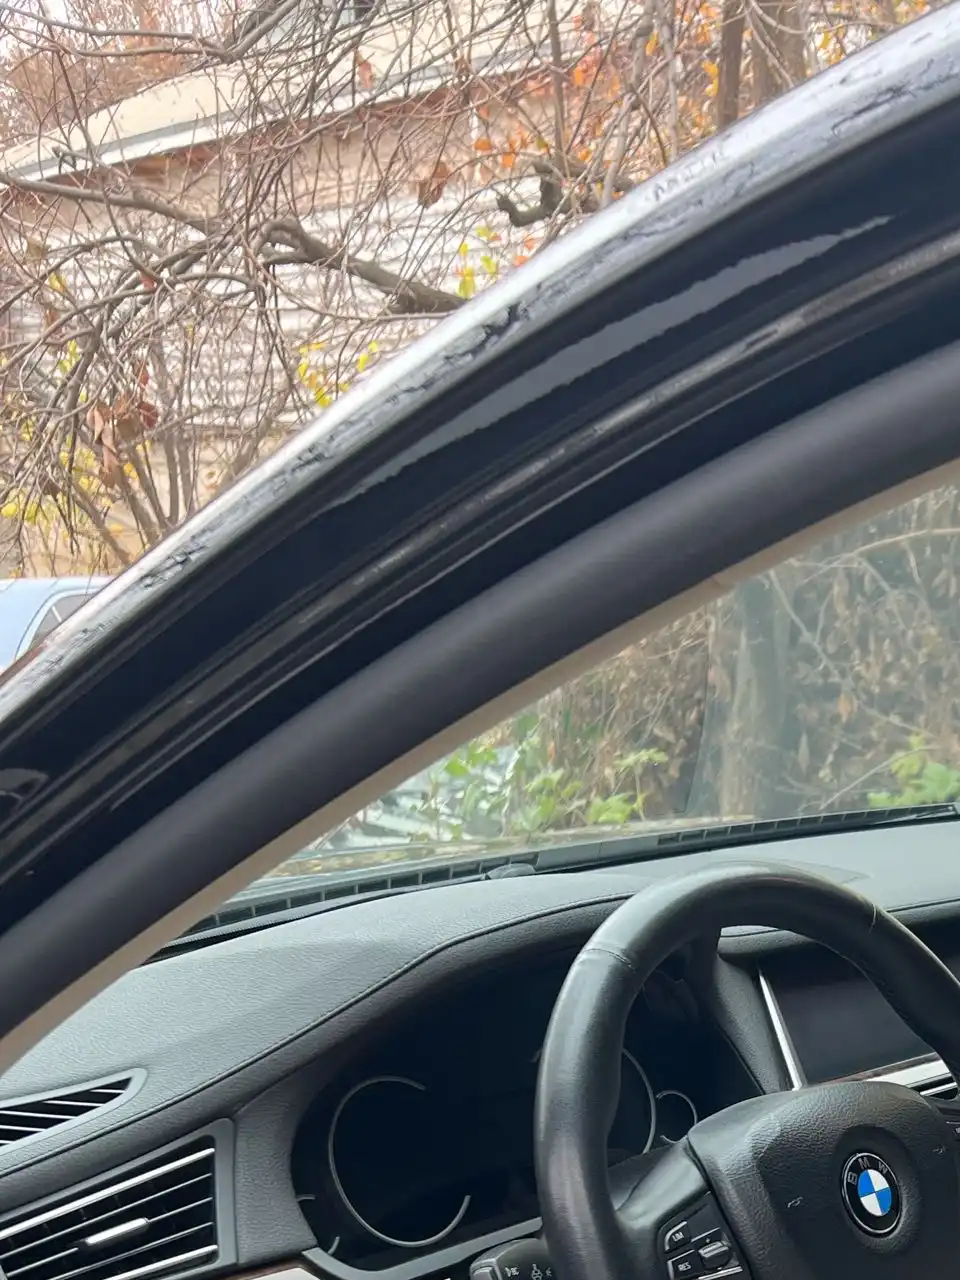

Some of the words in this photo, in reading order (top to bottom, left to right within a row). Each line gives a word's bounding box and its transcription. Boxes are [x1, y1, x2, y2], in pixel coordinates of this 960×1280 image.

[848, 1156, 889, 1186] BMW
[672, 1231, 685, 1242] LIM
[677, 1261, 692, 1272] RES
